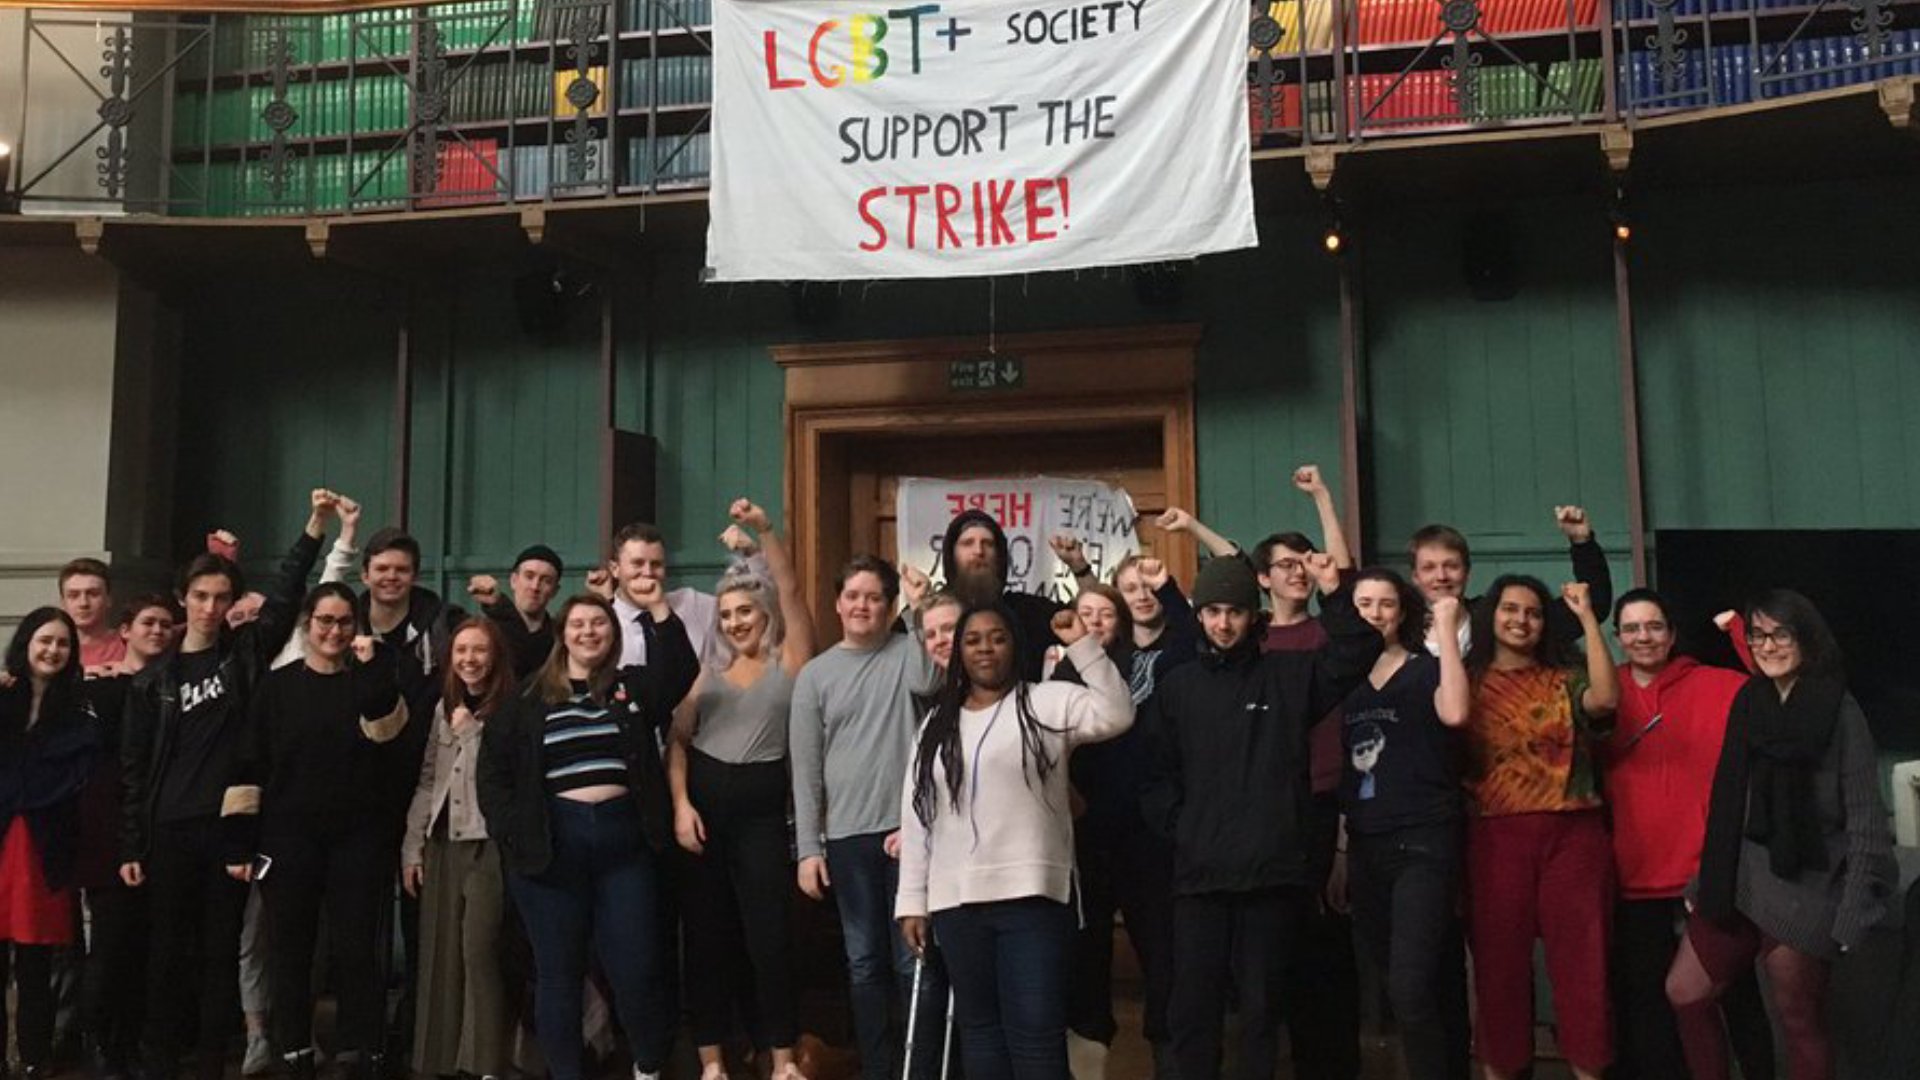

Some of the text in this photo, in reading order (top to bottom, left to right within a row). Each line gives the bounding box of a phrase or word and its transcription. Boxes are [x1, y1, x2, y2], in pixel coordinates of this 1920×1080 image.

[764, 0, 1146, 89] LGBT+ SOCIETY
[839, 96, 1116, 163] SUPPORT THE
[858, 177, 1069, 251] STRIKE!
